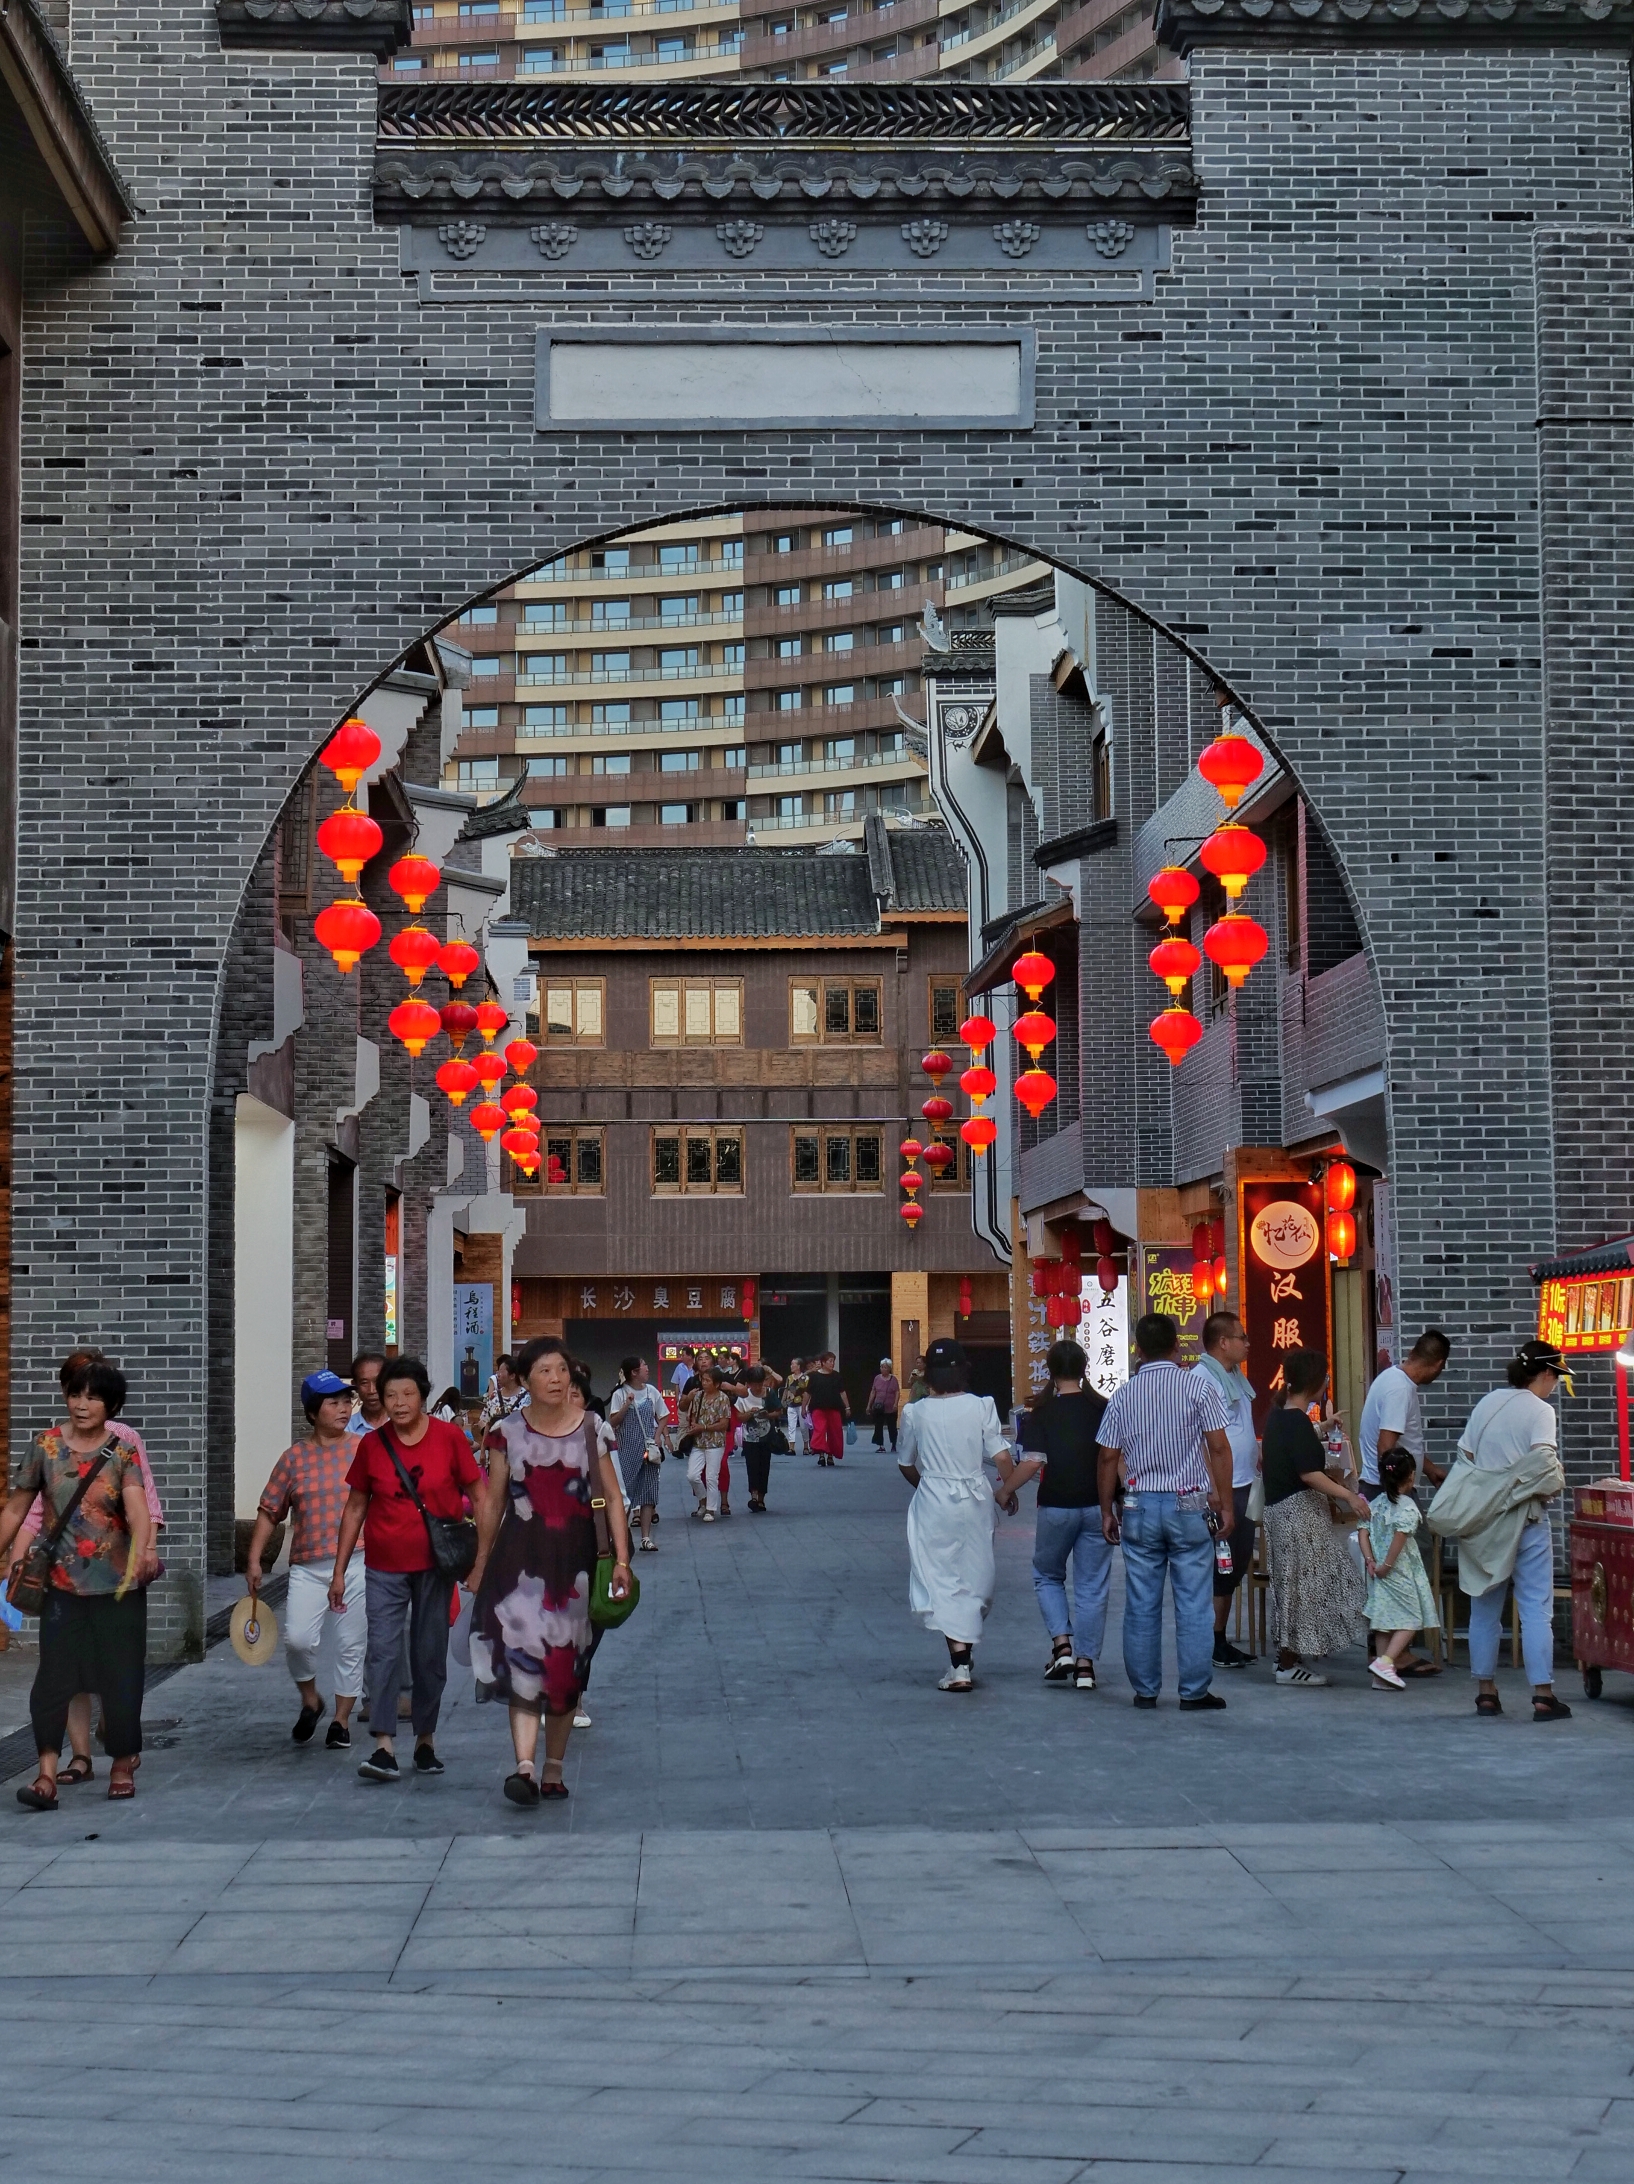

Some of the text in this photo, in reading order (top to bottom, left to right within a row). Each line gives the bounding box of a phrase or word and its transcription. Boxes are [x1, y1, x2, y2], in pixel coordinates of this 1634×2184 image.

[580, 1286, 736, 1311] 长沙臭豆腐
[1027, 1273, 1051, 1396] 汁铁板
[1096, 1291, 1119, 1393] 五谷磨坊
